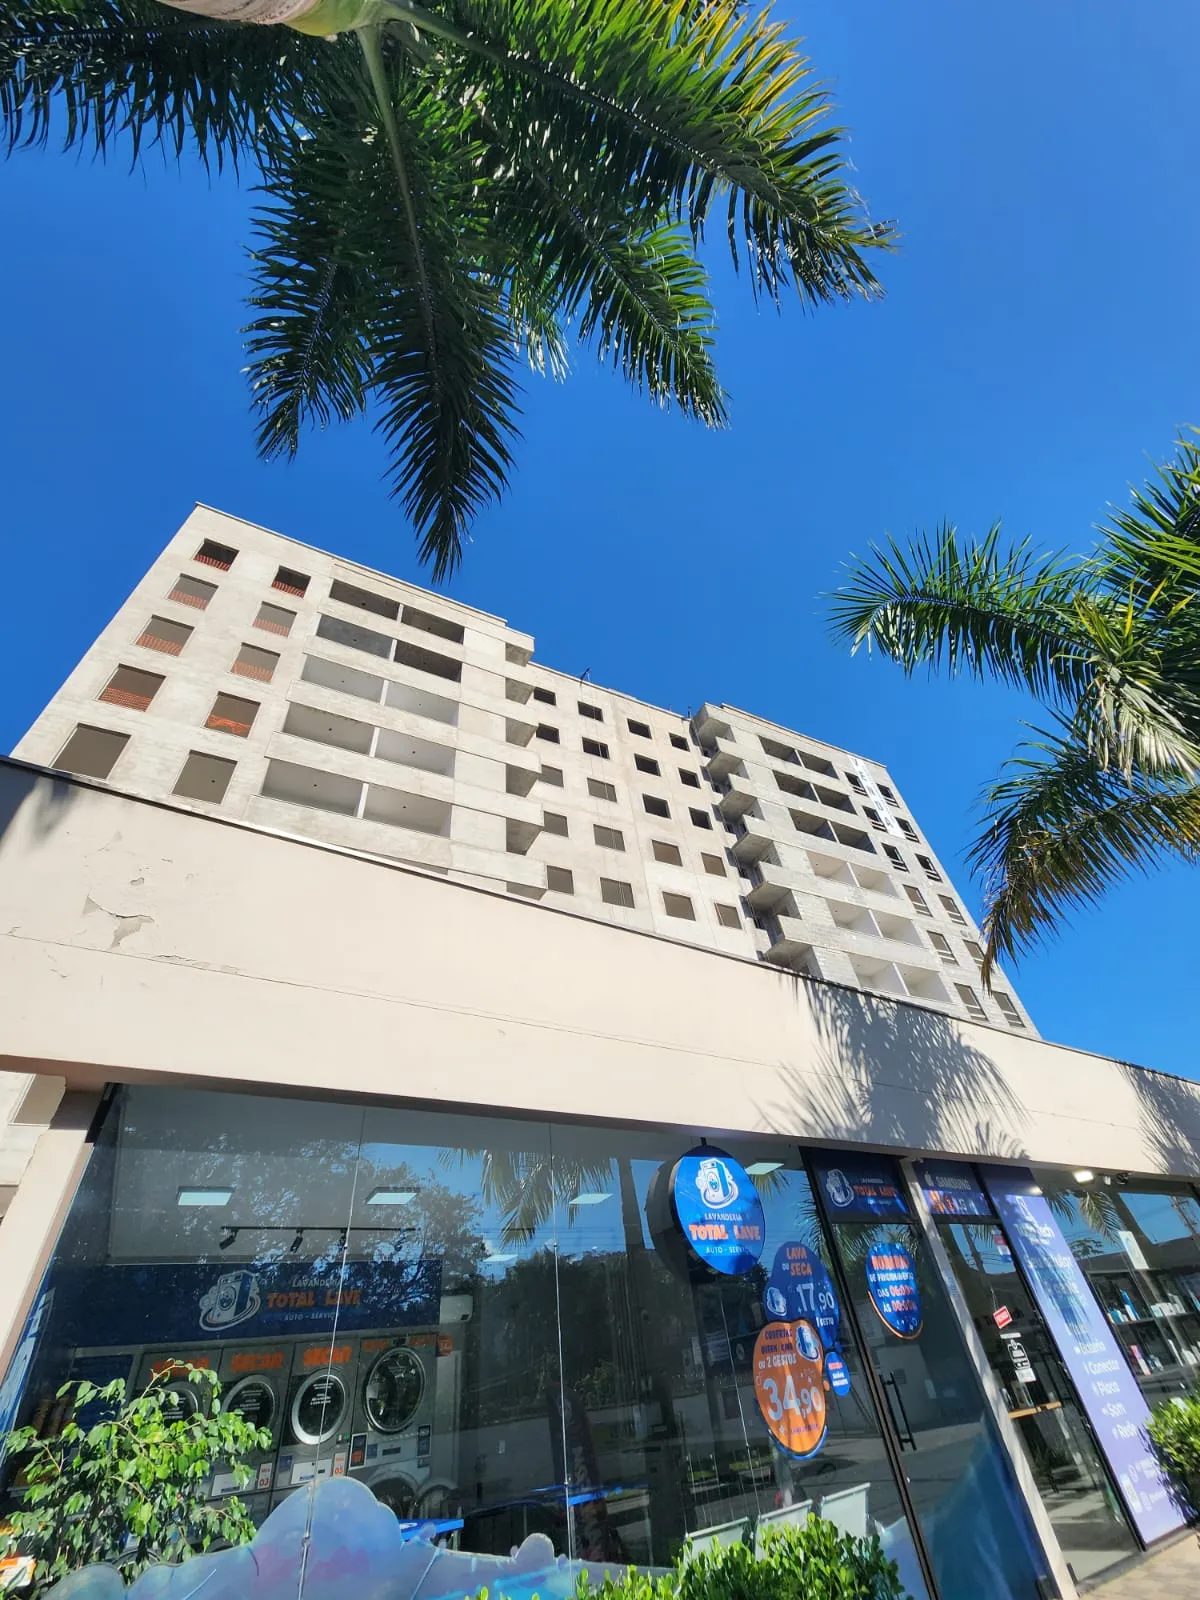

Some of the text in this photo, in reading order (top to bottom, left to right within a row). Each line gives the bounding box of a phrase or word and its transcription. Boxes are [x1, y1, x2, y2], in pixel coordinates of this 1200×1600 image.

[704, 1212, 743, 1221] LAVANDERIA
[688, 1224, 761, 1240] TOTAL LAVE
[706, 1246, 723, 1254] AUTO
[786, 1247, 807, 1260] LAVA
[790, 1262, 812, 1276] SECA
[267, 1288, 361, 1309] TOTAL LAVE
[877, 1288, 890, 1297] DAS
[284, 1312, 304, 1320] AUTO
[303, 1345, 353, 1367] SECAR
[766, 1357, 772, 1369] 2
[772, 1353, 797, 1368] CESTOS
[763, 1375, 822, 1421] 34,90
